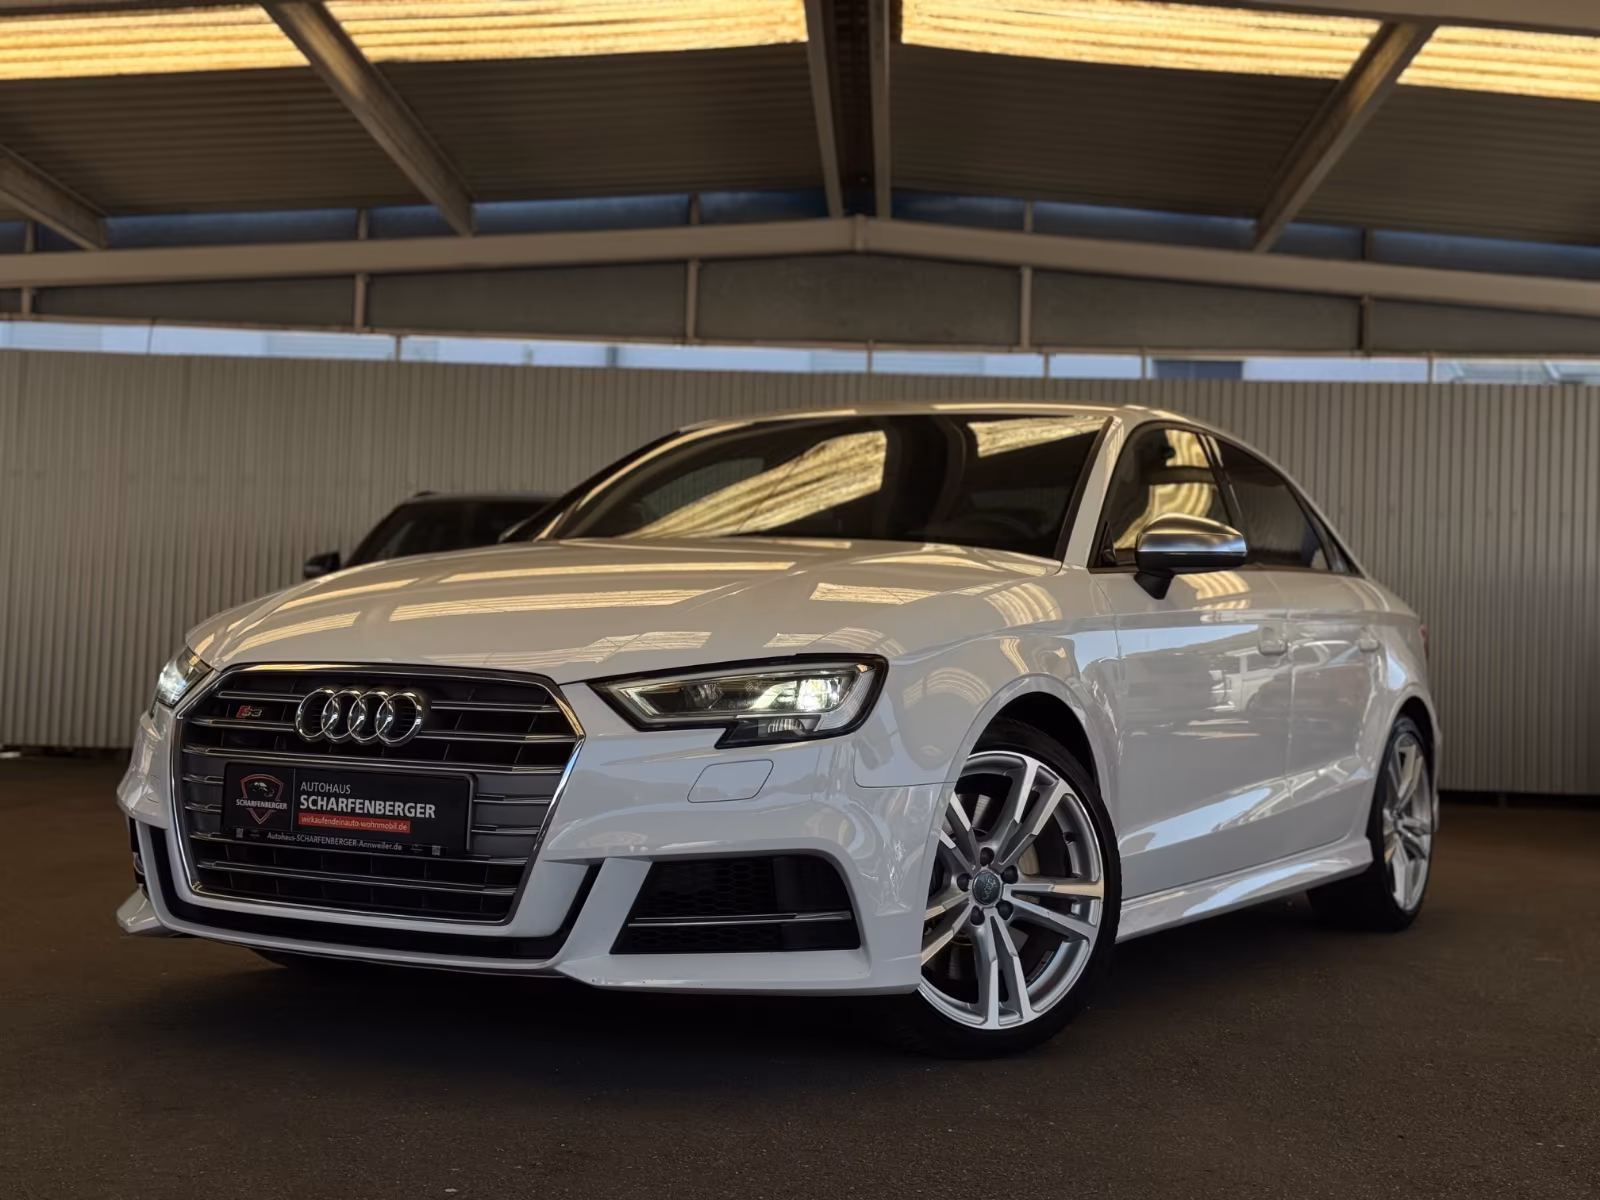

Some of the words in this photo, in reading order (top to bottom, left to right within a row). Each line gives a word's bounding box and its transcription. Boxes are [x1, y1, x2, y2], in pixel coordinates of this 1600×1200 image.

[236, 705, 263, 718] S3
[300, 781, 351, 794] AUTOHAUS
[235, 798, 288, 810] SCHARFENBERGER
[300, 795, 436, 818] SCHARFENBERGER
[301, 815, 408, 831] wirkaufendeinauto-wohnmobil.de
[266, 831, 403, 851] Autohaus-SCHARFENBERGER-Annweiler.de
